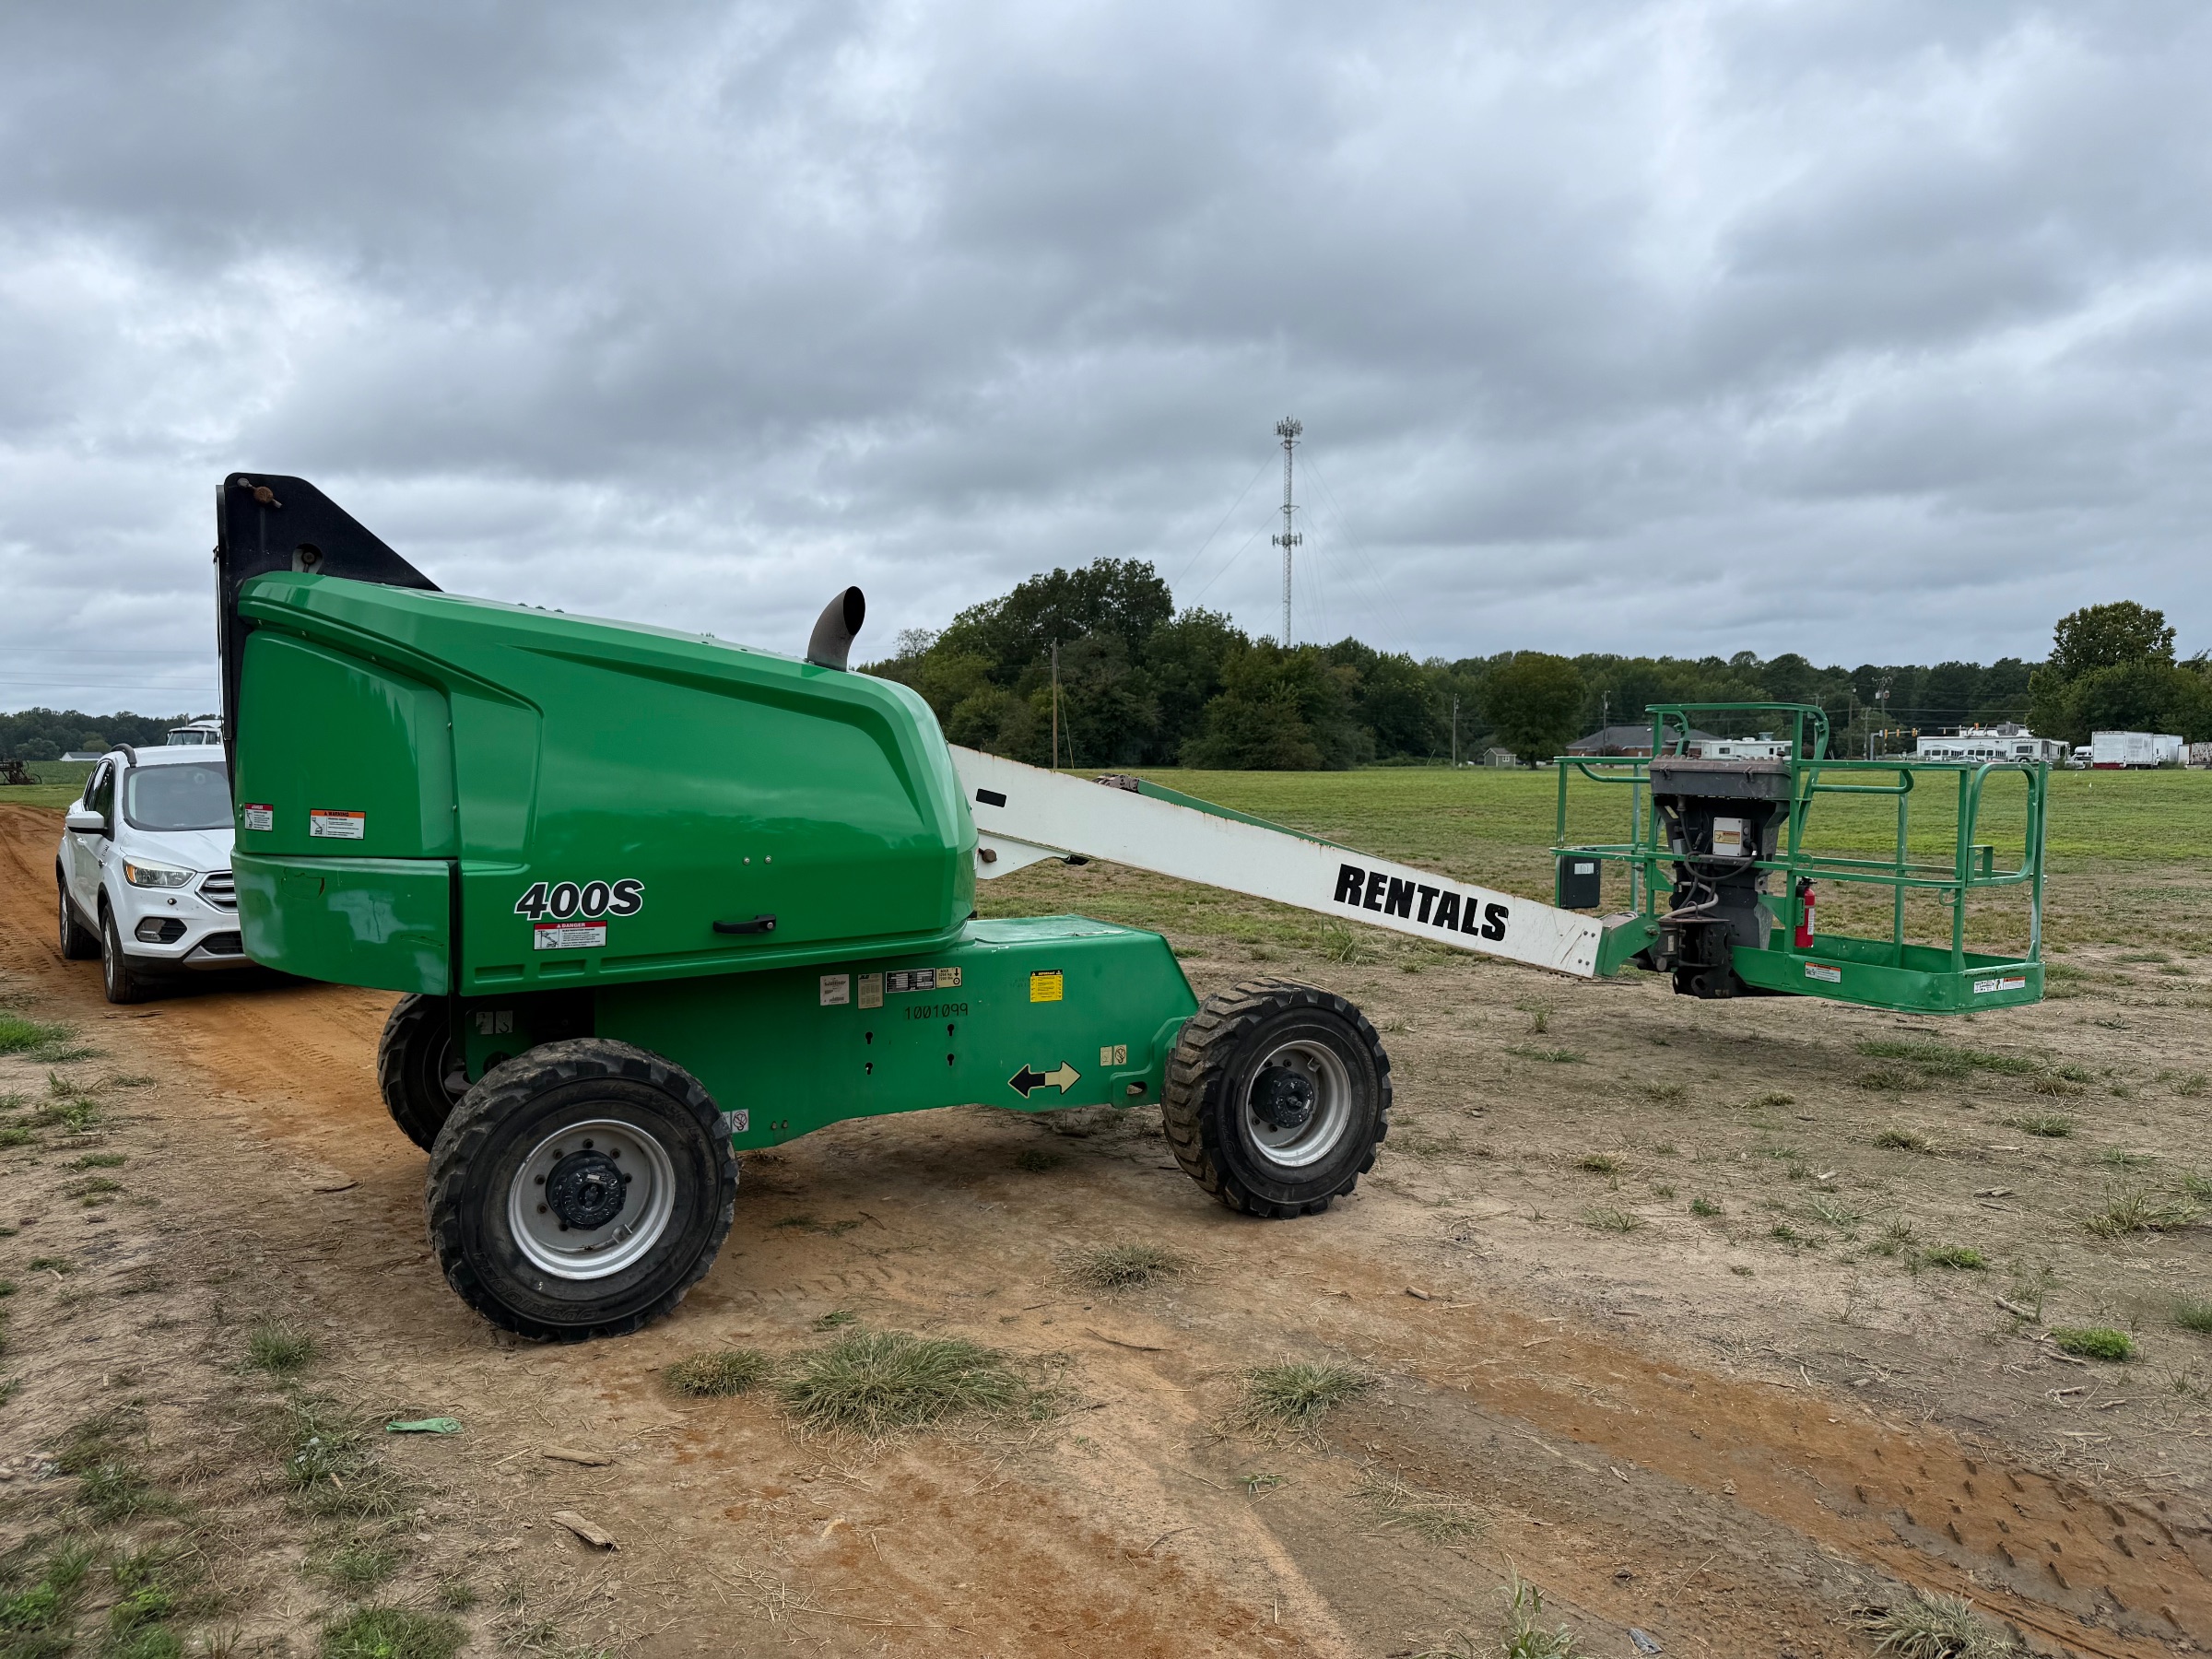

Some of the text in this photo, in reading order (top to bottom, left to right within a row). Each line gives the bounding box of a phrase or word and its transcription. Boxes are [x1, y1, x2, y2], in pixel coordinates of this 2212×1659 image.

[514, 878, 645, 921] 400S
[1334, 864, 1510, 942] RENTALS
[904, 1002, 969, 1020] 1001099
